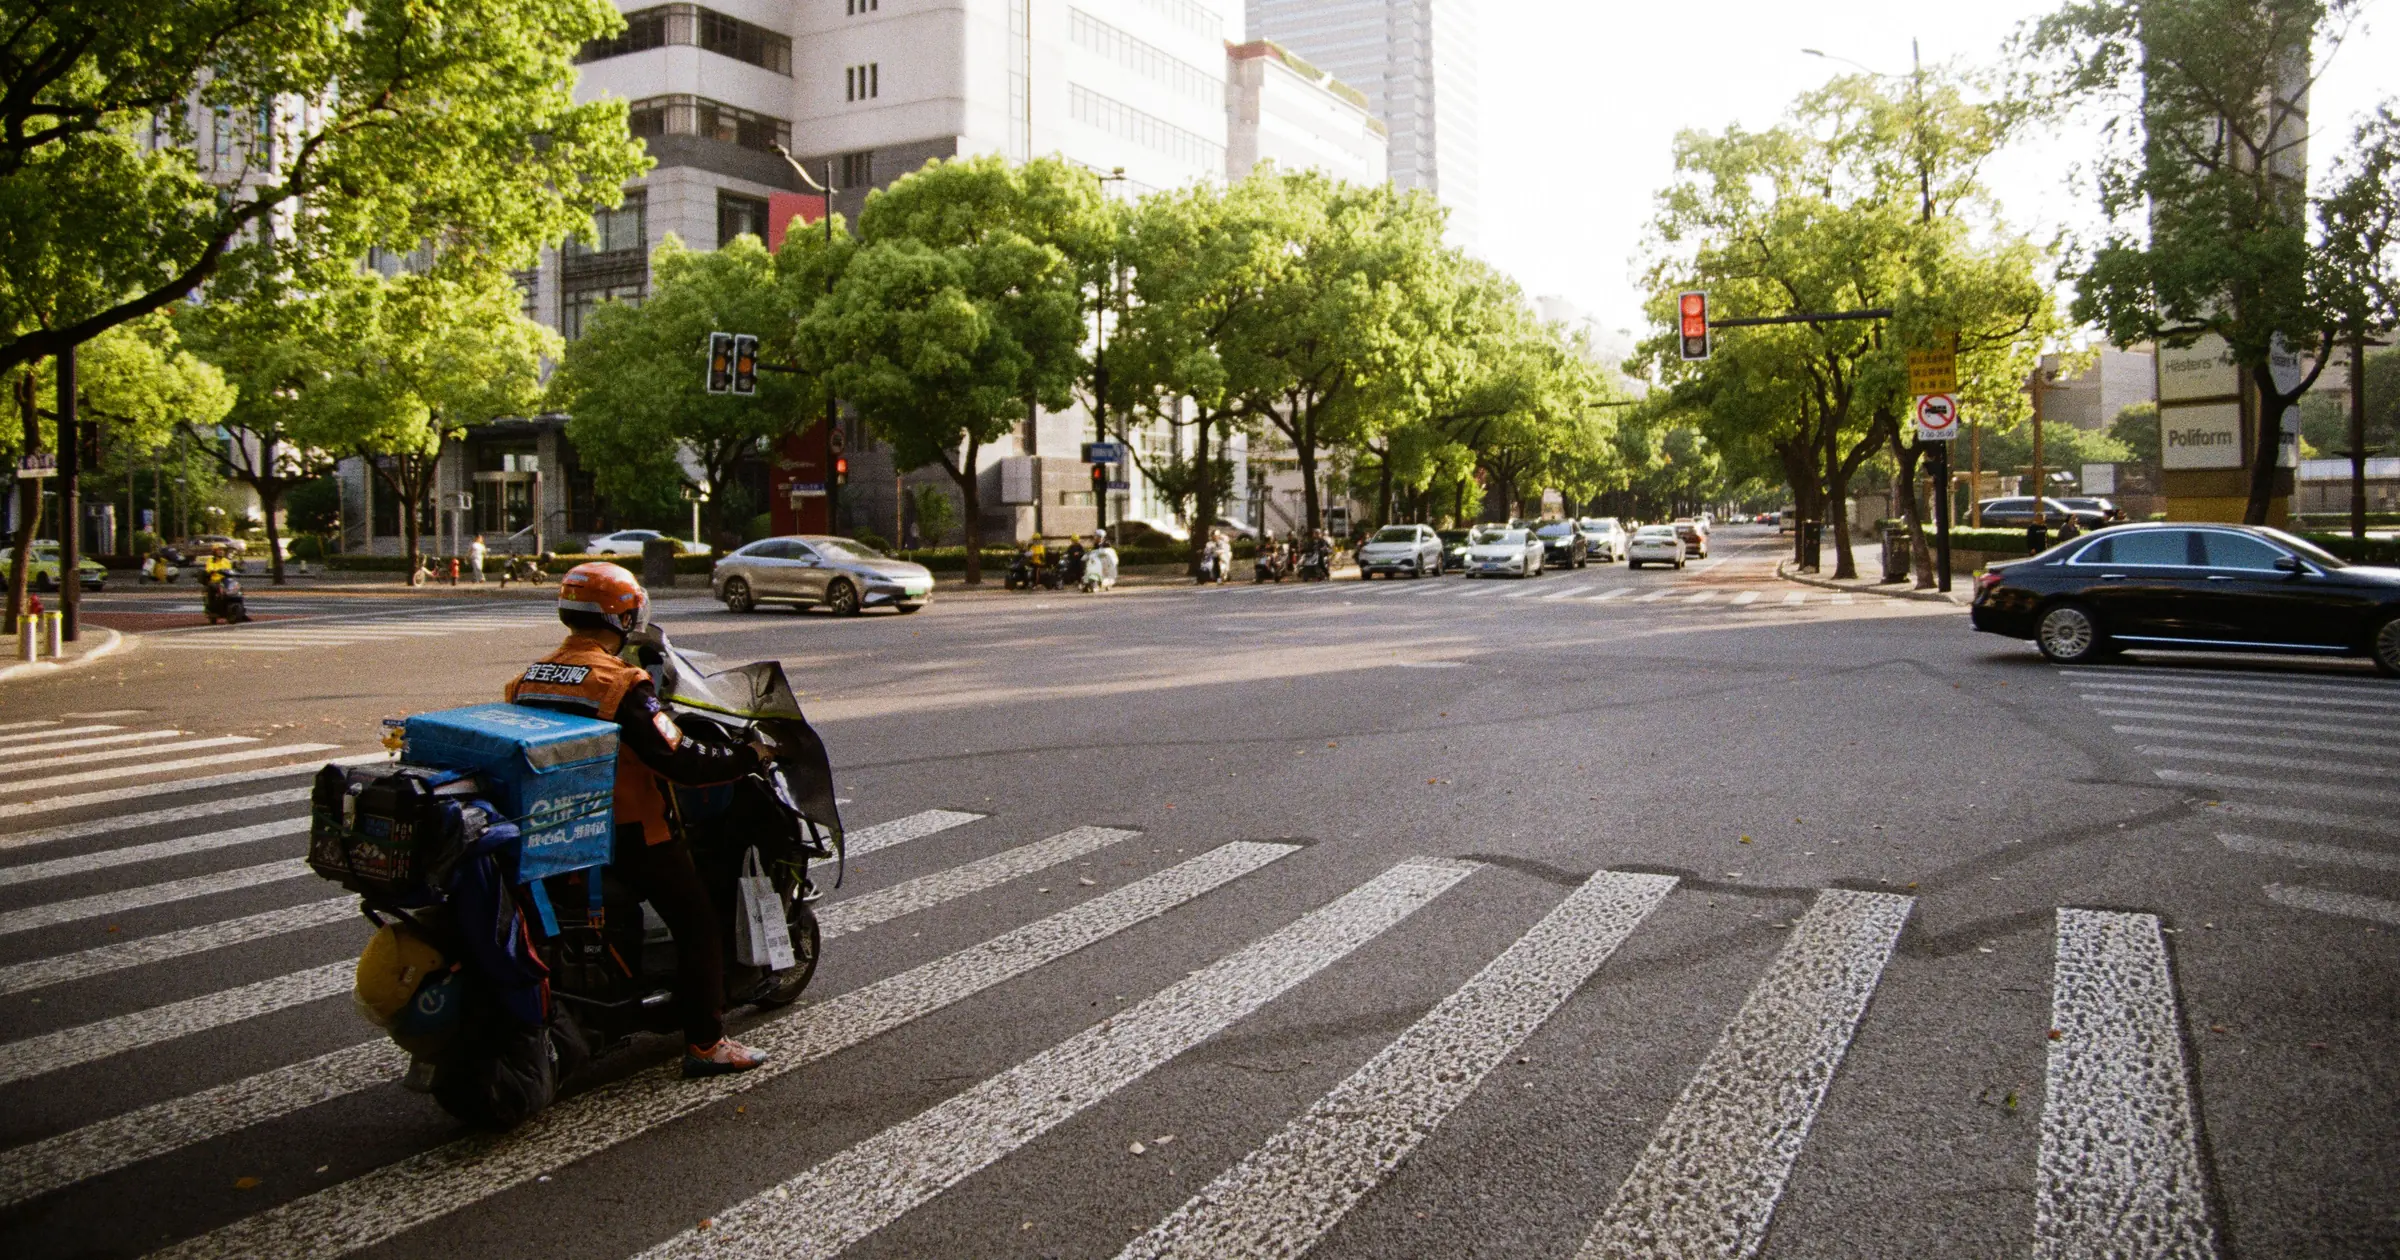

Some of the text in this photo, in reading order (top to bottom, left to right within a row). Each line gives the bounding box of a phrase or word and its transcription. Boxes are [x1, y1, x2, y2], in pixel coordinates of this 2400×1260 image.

[2168, 427, 2233, 447] Poliform
[525, 663, 588, 683] 淘宝闪购
